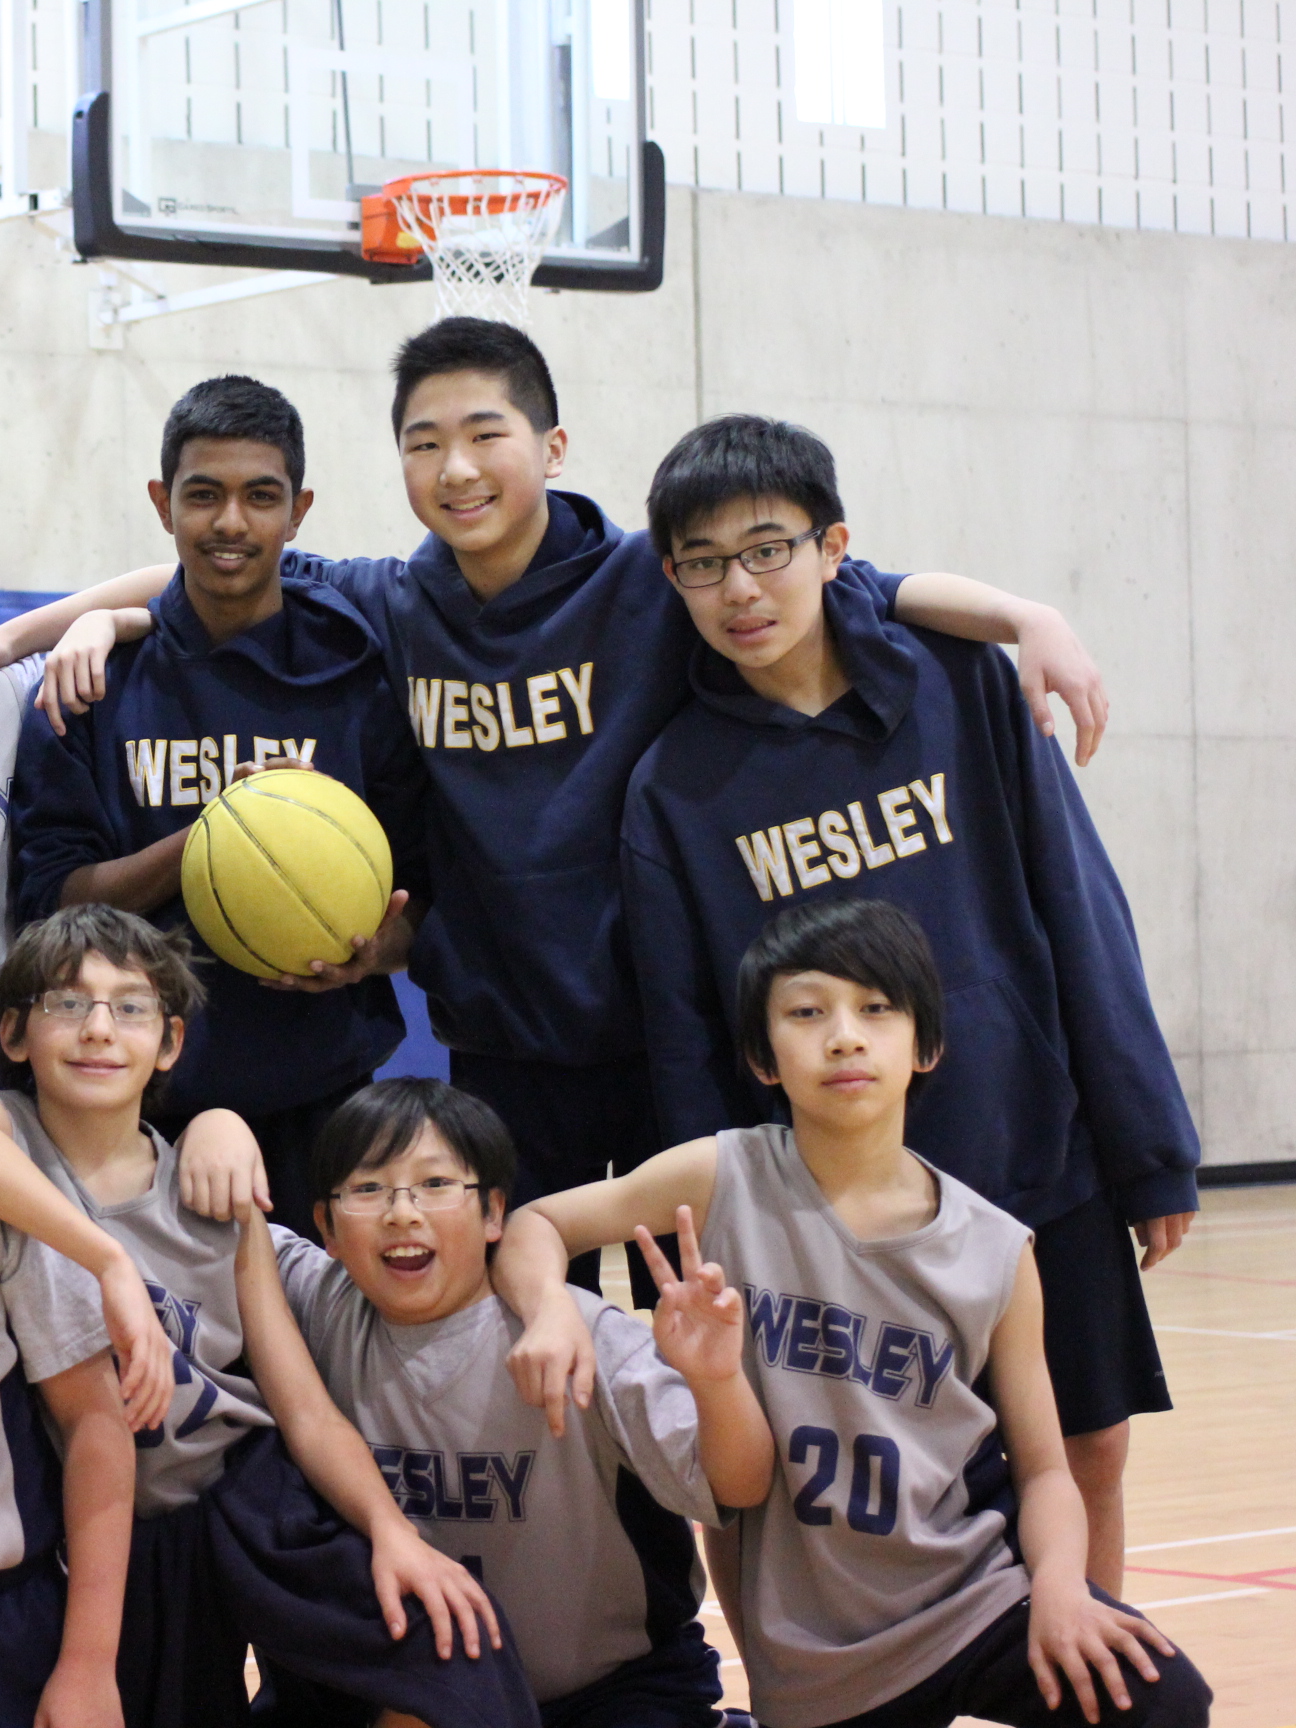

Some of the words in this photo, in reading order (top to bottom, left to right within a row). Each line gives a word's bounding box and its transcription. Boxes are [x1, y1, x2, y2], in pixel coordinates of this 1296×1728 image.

[407, 662, 594, 752] WESLEY
[735, 773, 953, 901] WESLEY
[743, 1284, 954, 1409] WESLEY
[367, 1443, 535, 1522] ESLEY
[789, 1425, 900, 1536] 20
